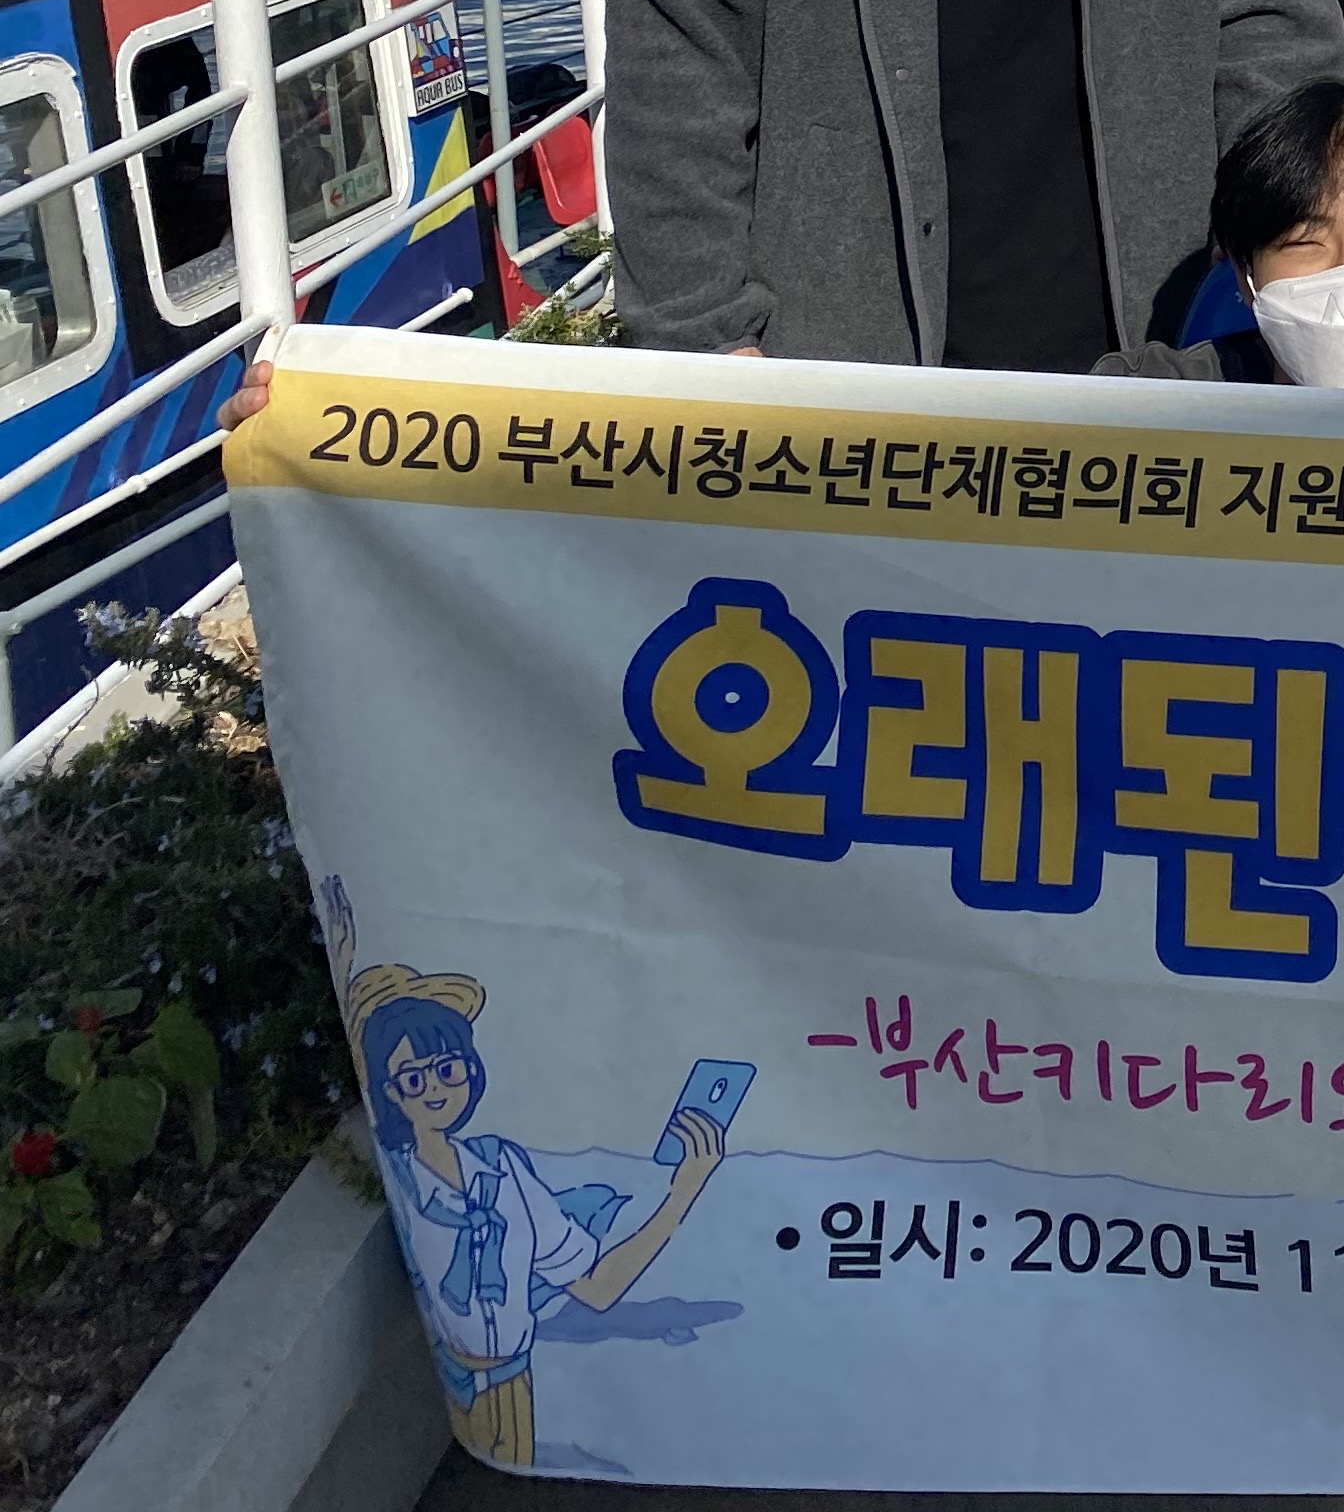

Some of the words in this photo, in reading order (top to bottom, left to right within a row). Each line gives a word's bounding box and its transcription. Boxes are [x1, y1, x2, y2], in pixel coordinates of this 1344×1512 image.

[416, 81, 444, 107] AQUA
[444, 73, 464, 96] BUS
[308, 403, 482, 474] 2020
[496, 414, 1205, 531] 부산시청소년단체협의회
[1009, 1207, 1260, 1293] 2020년
